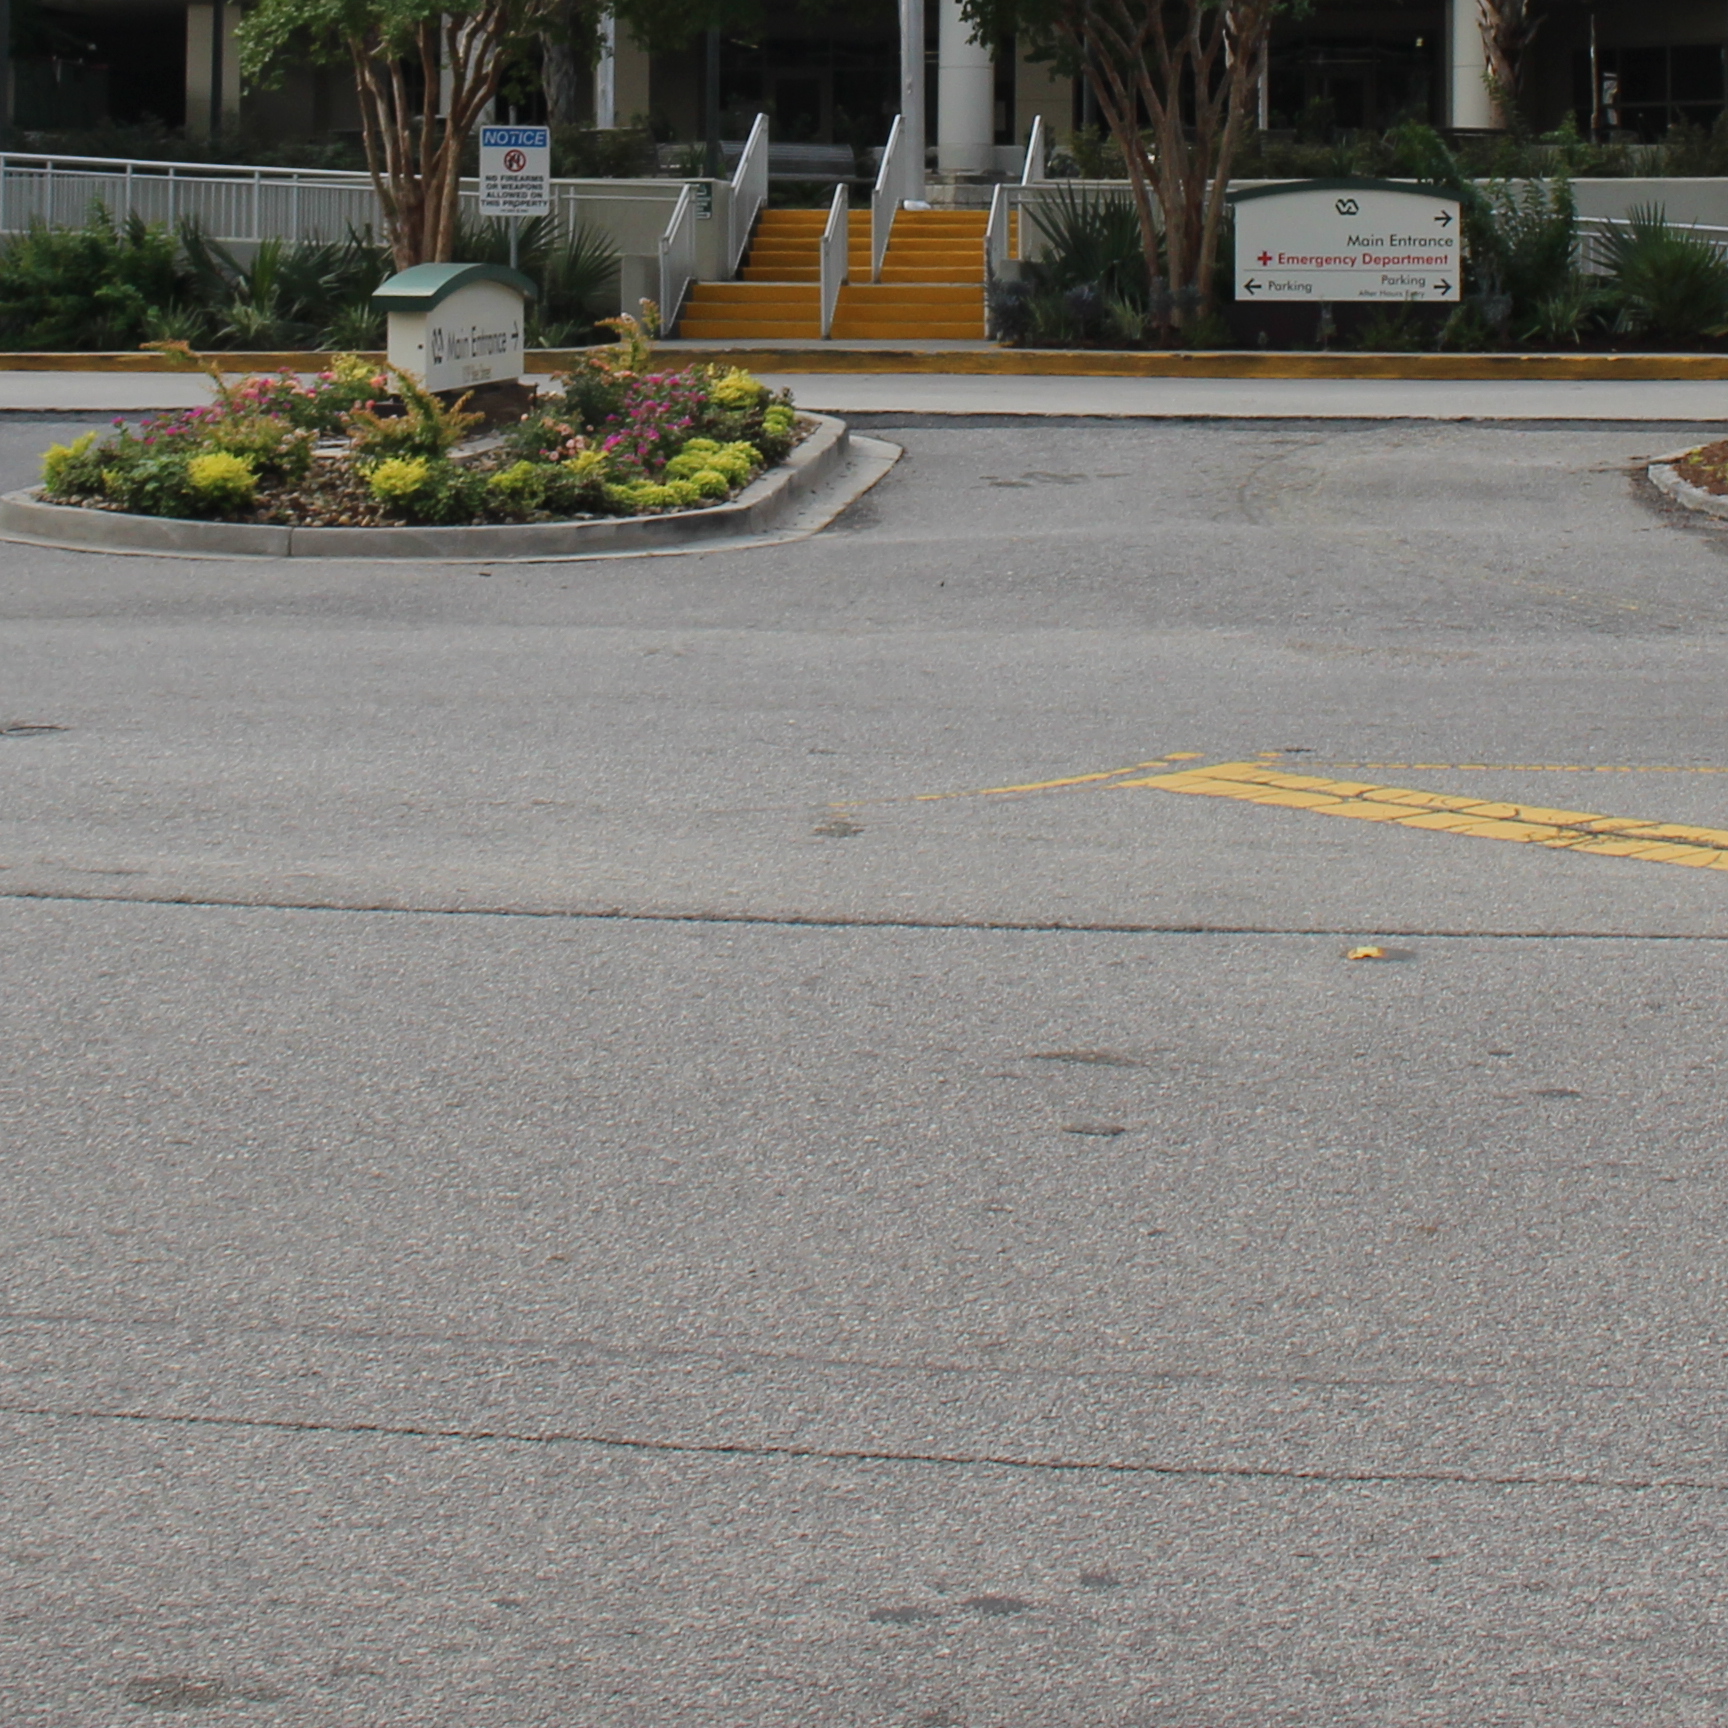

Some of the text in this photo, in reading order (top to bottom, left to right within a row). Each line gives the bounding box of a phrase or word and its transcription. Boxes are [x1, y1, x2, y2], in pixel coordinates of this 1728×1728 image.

[485, 131, 545, 145] NOTICE
[1347, 234, 1453, 247] Main Entrance
[1278, 253, 1448, 267] Emergency Department
[1268, 280, 1313, 293] Parking
[1381, 275, 1426, 288] Parking
[471, 326, 506, 357] Entrance
